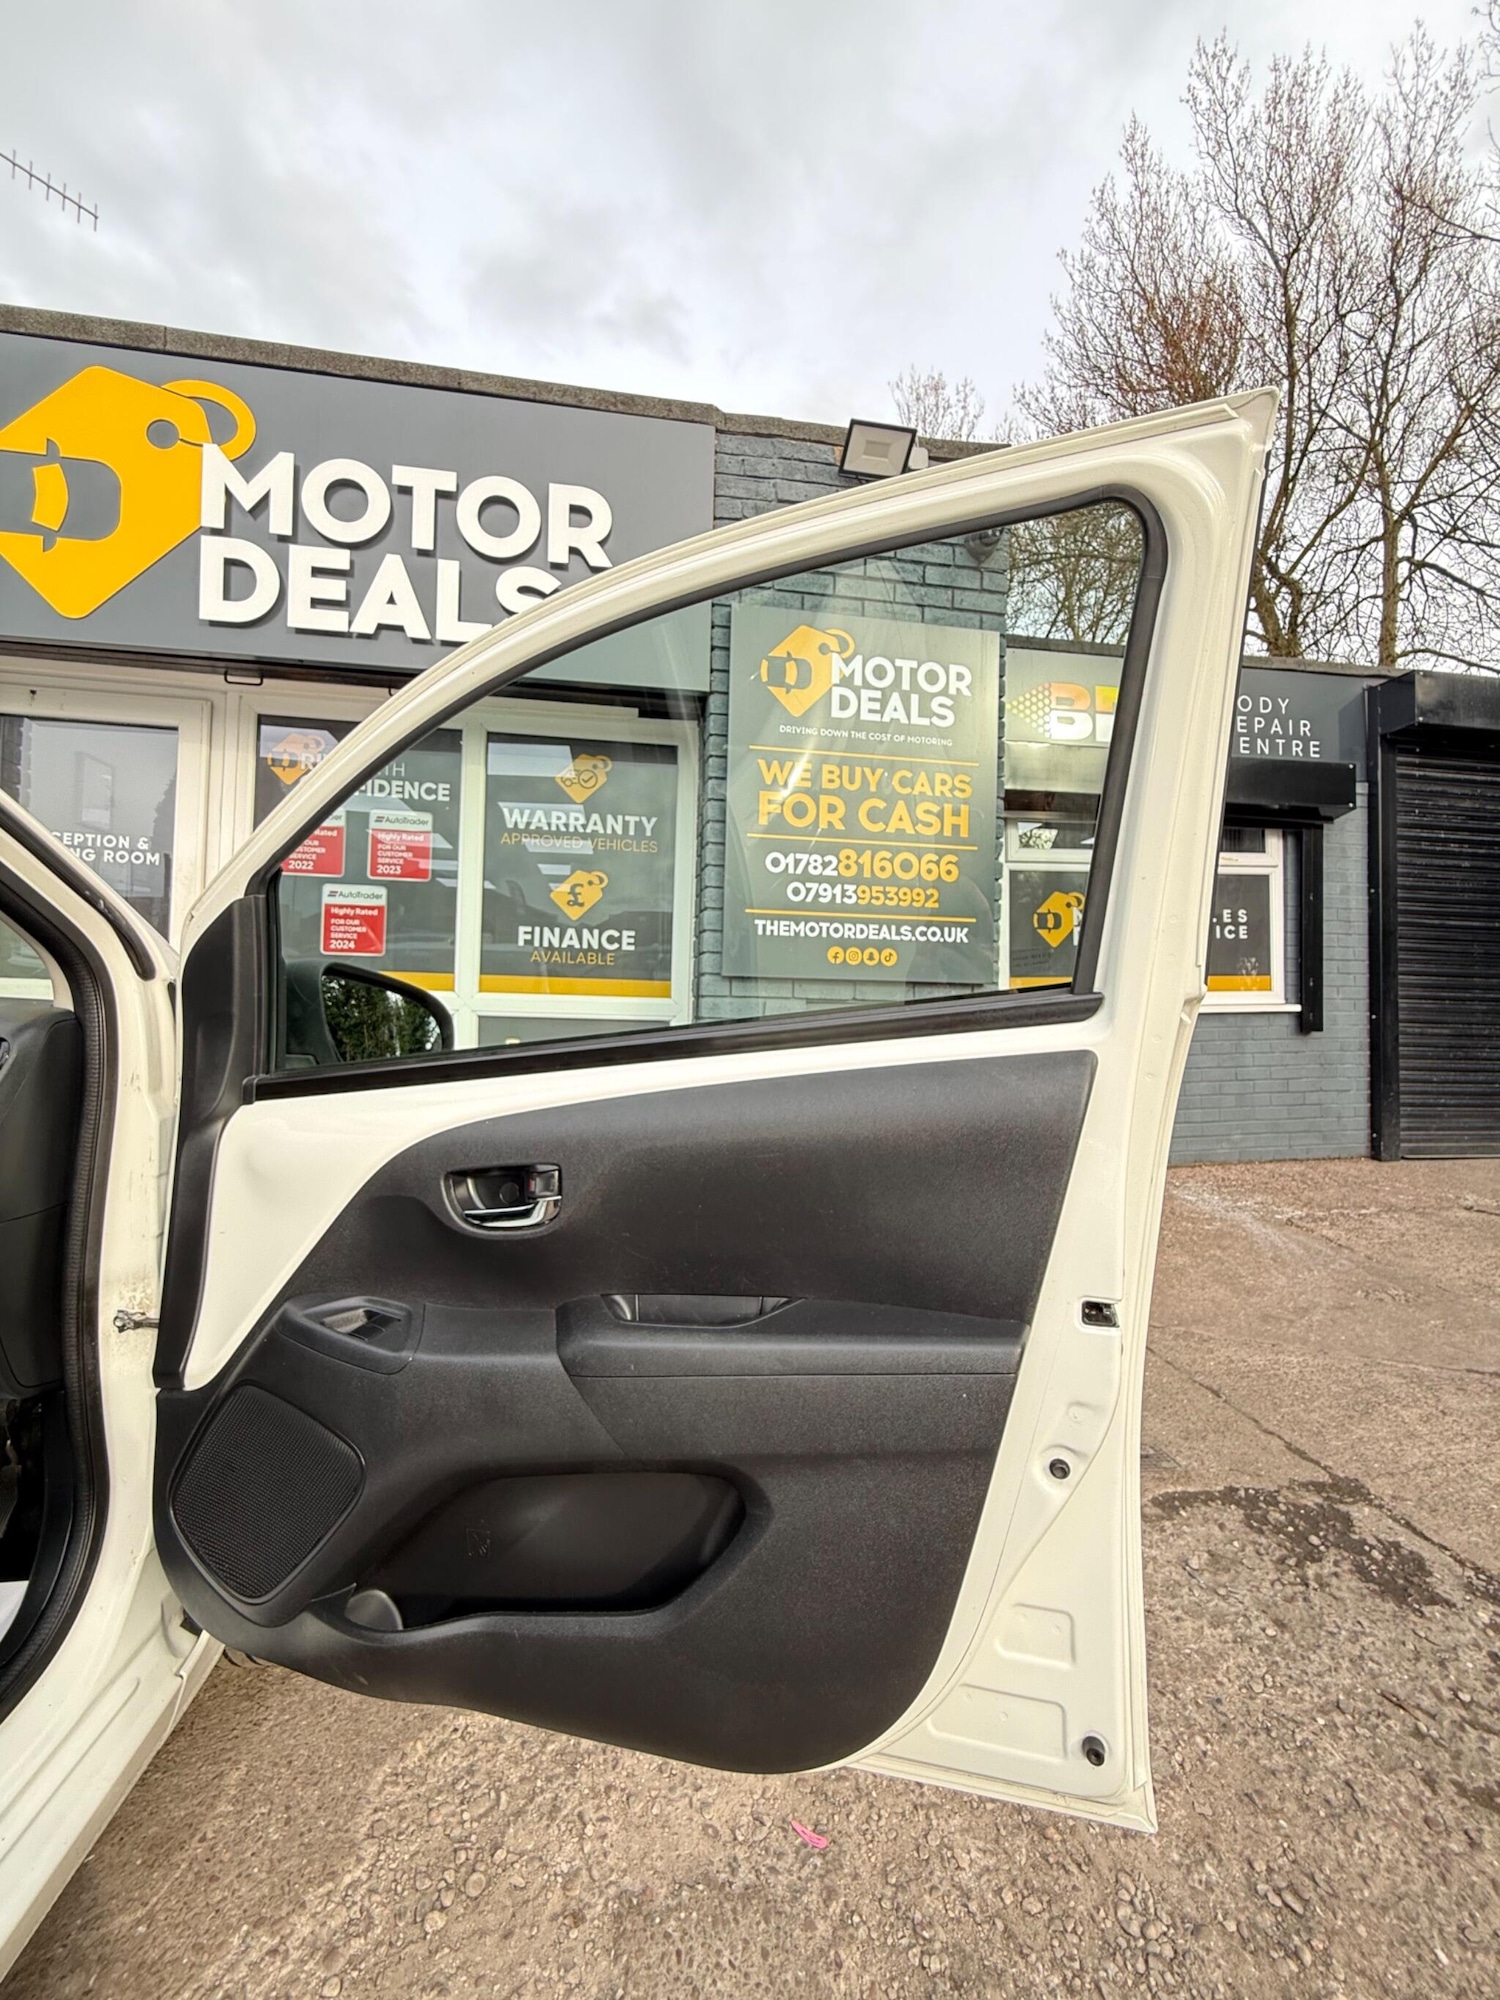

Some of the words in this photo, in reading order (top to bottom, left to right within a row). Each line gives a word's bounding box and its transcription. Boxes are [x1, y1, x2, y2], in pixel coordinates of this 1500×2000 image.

[200, 442, 613, 568] MOTOR
[831, 652, 972, 697] MOTOR
[831, 686, 956, 728] DEALS
[1237, 695, 1289, 715] ODY
[779, 725, 818, 735] DRIVING
[820, 728, 849, 738] DOWN
[850, 731, 867, 740] THE
[868, 732, 891, 742] COST
[893, 734, 905, 743] OF
[907, 736, 953, 747] MOTORING
[1237, 716, 1311, 737] EPAIR
[1239, 737, 1320, 758] ENTRE
[757, 758, 812, 788] WE
[821, 763, 884, 792] BUY
[891, 769, 973, 799] CARS
[385, 816, 429, 826] AutoTrader
[502, 807, 658, 837] WARRANTY
[757, 790, 846, 831] FOR
[857, 797, 970, 838] CASH
[51, 831, 130, 849] EPTION
[137, 837, 149, 850] &
[401, 833, 424, 842] Rated
[500, 832, 584, 849] APPROVED
[588, 838, 658, 853] VEHICLES
[103, 850, 160, 865] ROOM
[377, 850, 413, 858] CUSTOMER
[288, 860, 314, 870] 2022
[376, 864, 402, 875] 2023
[765, 848, 959, 882] 01782816066
[339, 891, 383, 900] AutoTrader
[786, 881, 940, 908] 07913953992
[330, 906, 354, 916] Highly
[355, 908, 379, 916] Rated
[330, 925, 367, 933] CUSTOMER
[517, 926, 636, 951] FINANCE
[754, 919, 969, 943] THEMOTORDEALS.CO.UK
[330, 939, 355, 950] 2024
[530, 950, 615, 966] AVAILABLE
